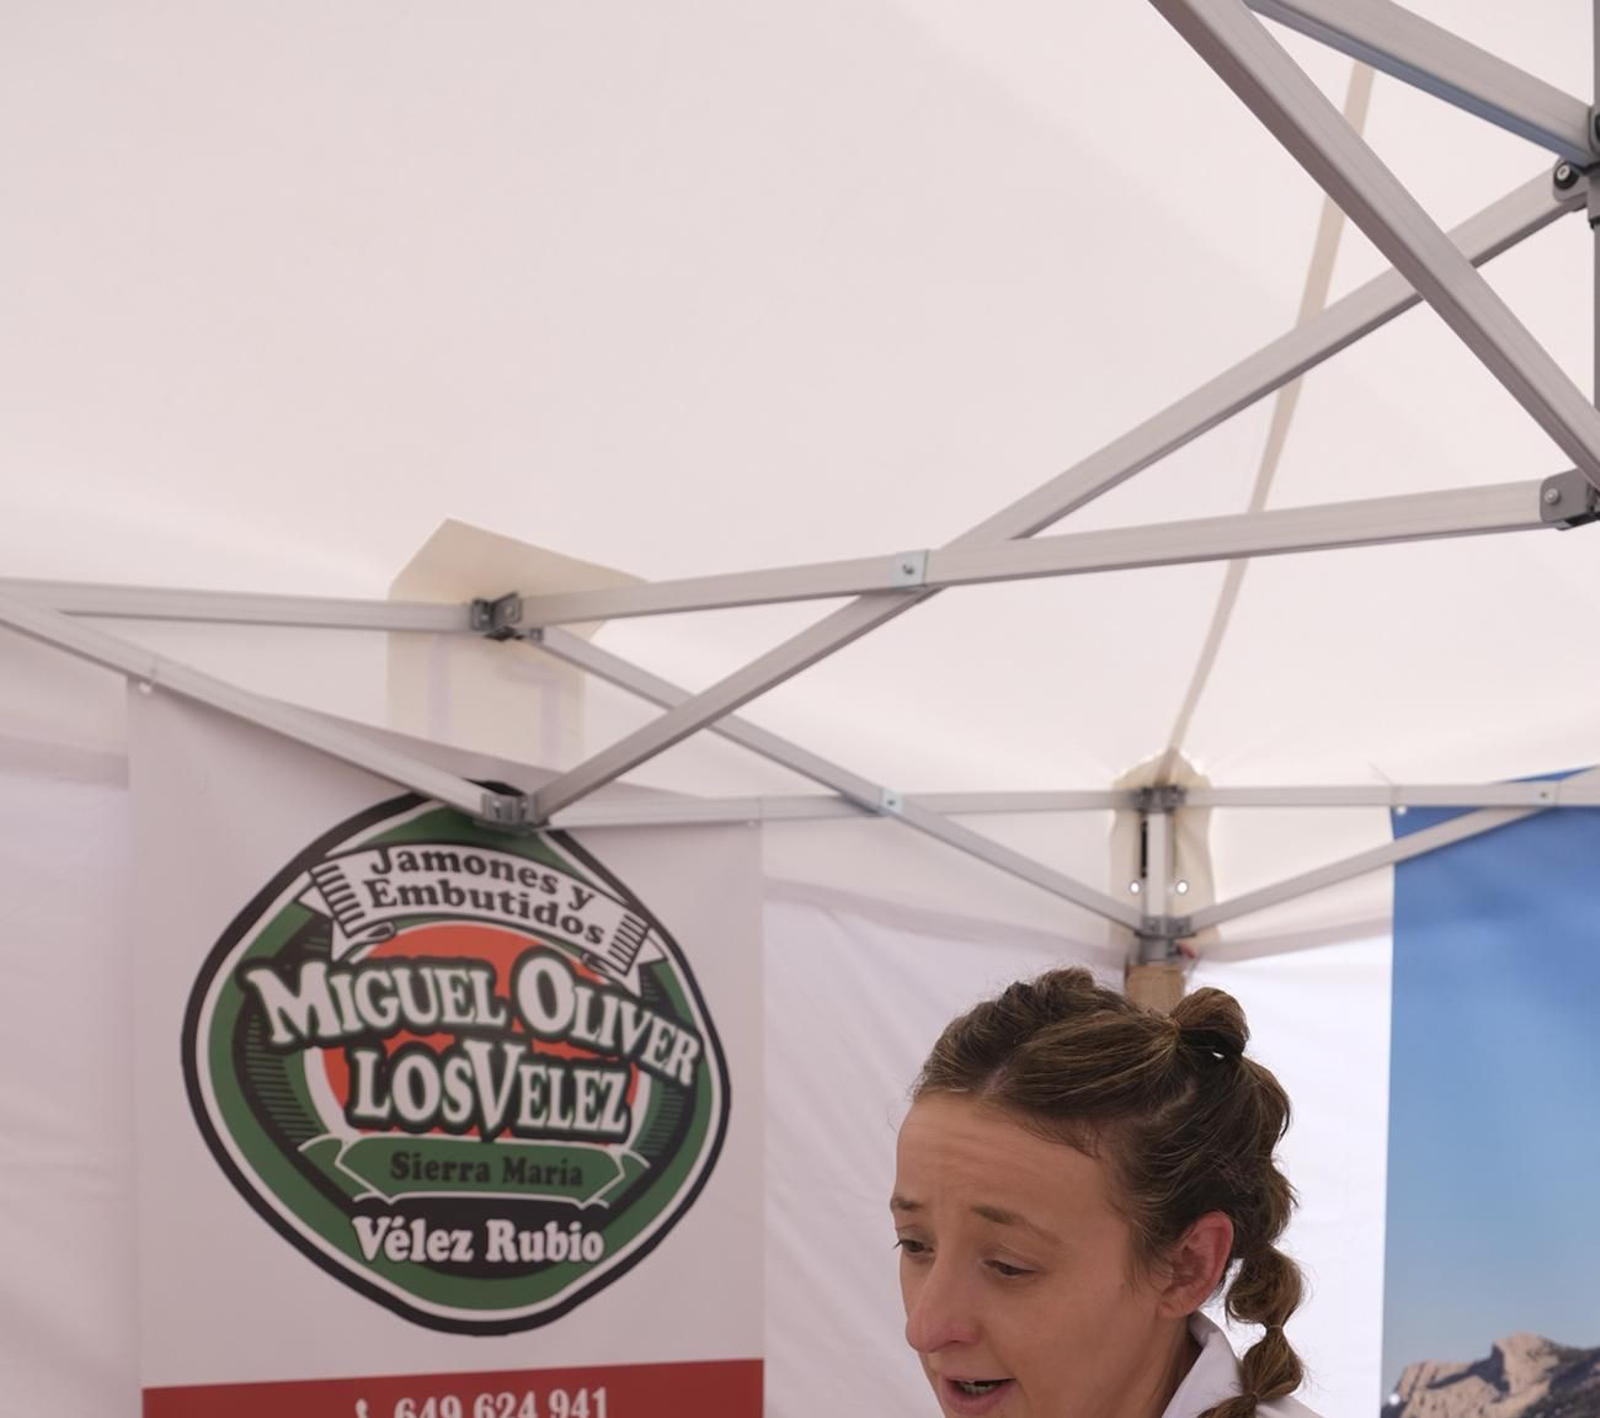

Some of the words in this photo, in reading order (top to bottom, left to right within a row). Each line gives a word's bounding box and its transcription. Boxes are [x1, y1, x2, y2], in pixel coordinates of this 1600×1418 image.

[371, 846, 560, 896] Jamones
[570, 884, 598, 911] y
[363, 877, 605, 946] Embutidos
[246, 961, 507, 1045] MIGUEL
[517, 952, 702, 1087] OLIVER
[390, 1151, 490, 1183] Sierra
[353, 1215, 475, 1263] Vélez
[486, 1220, 604, 1264] Rubio
